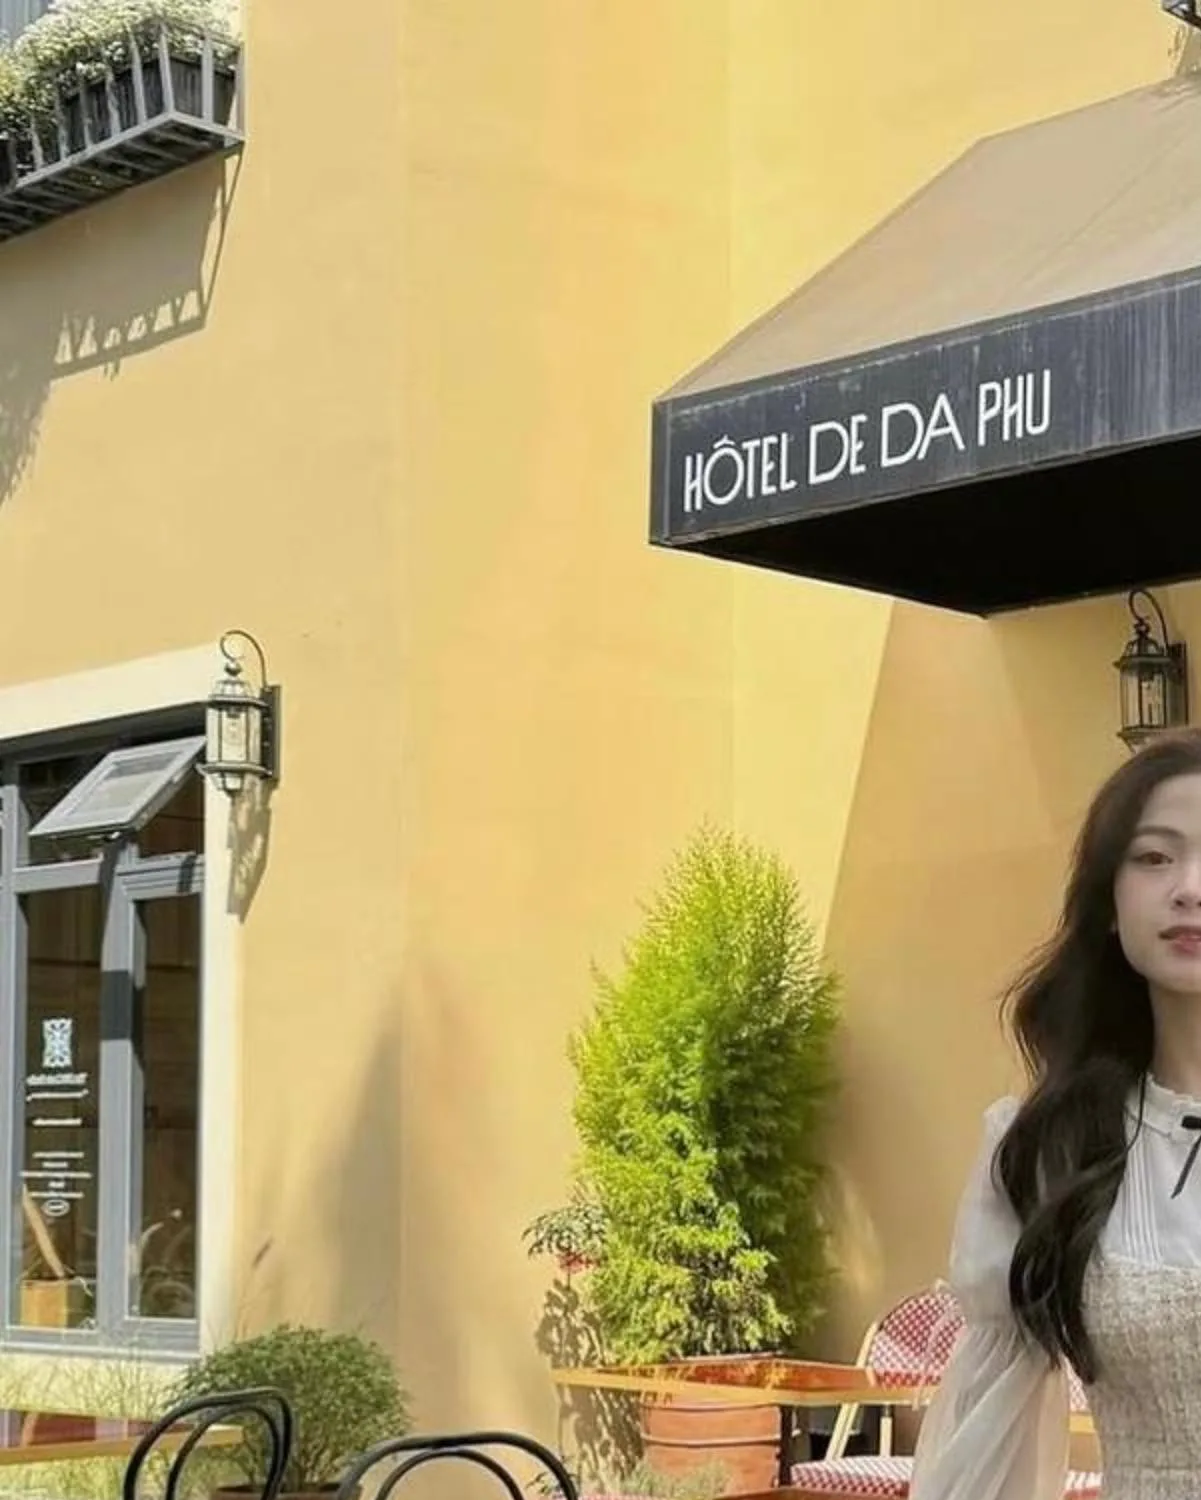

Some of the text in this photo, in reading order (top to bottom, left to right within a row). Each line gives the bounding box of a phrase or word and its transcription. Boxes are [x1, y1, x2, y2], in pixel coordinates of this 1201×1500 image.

[683, 368, 1051, 513] HÔTEL DE DA PHU
